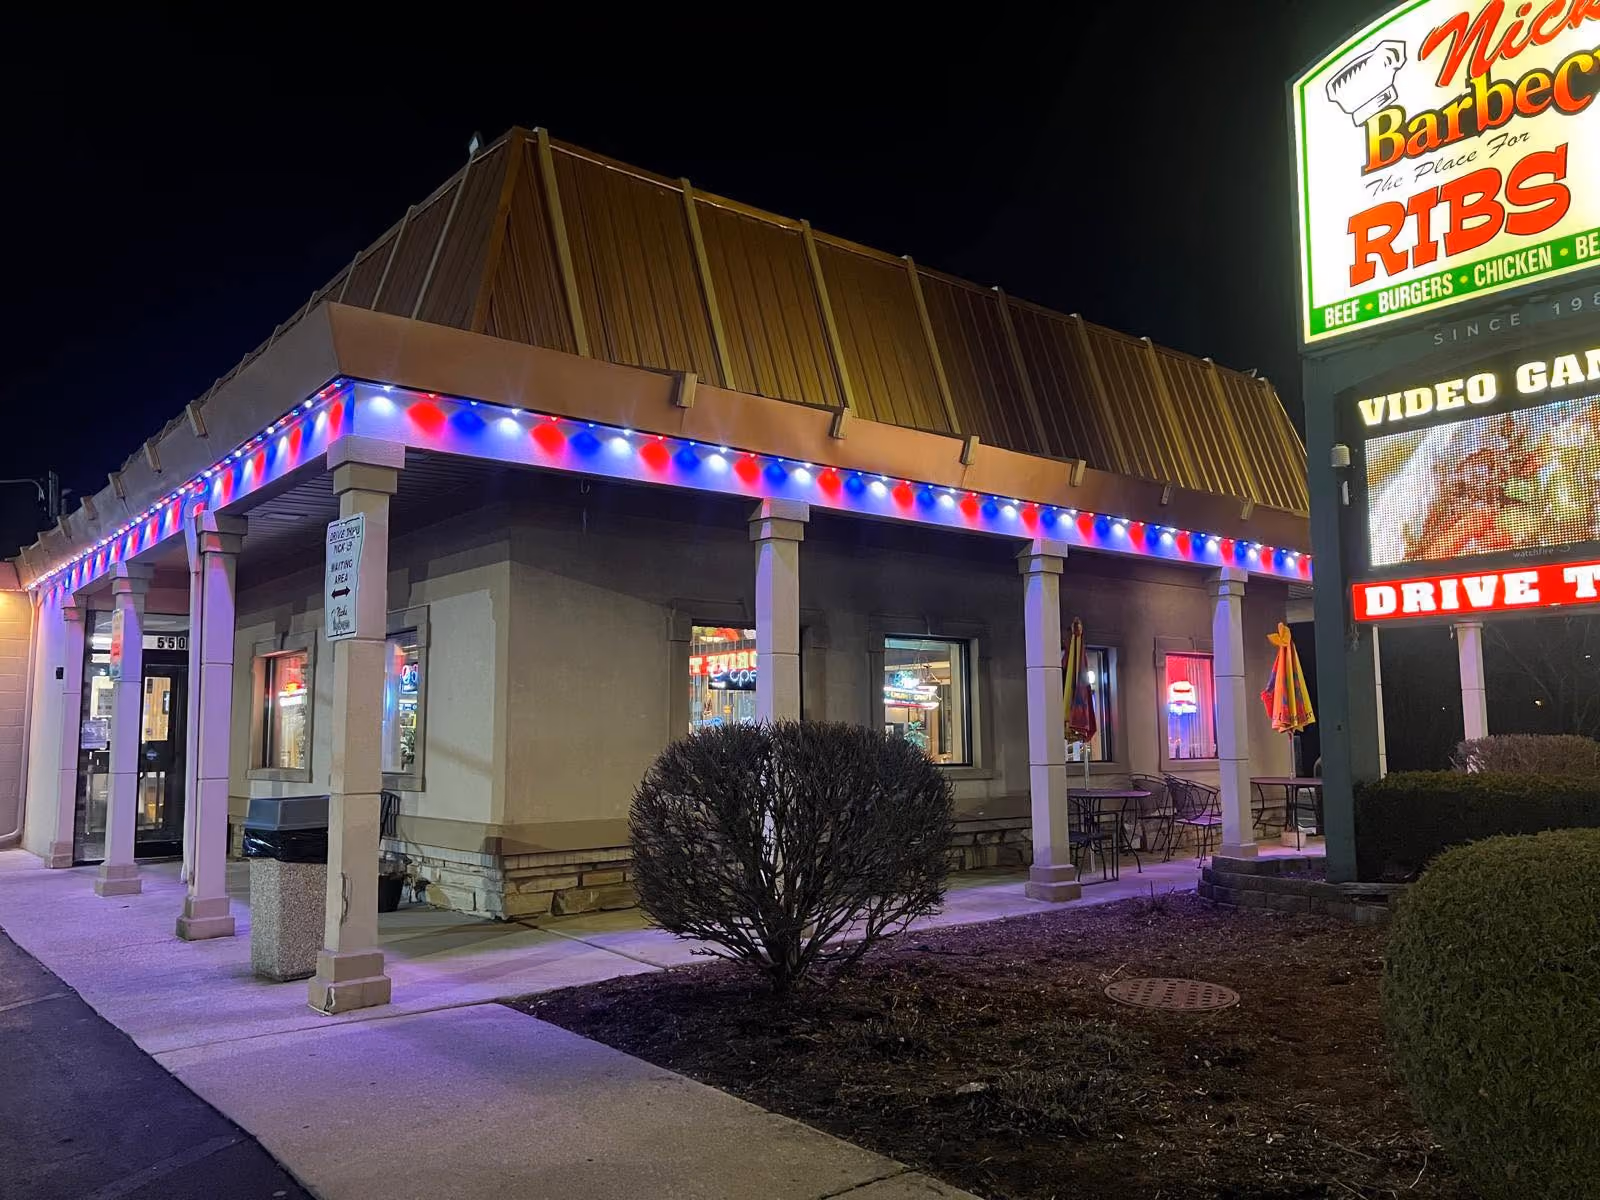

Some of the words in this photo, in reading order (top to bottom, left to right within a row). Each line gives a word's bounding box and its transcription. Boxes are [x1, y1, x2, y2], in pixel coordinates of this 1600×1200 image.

[1361, 46, 1600, 176] BarbeC
[1365, 174, 1403, 197] The
[1414, 150, 1478, 183] Place
[1486, 132, 1530, 158] For
[1347, 143, 1571, 287] RIBS
[1324, 299, 1361, 329] BEEF
[1378, 273, 1453, 313] BURGERS
[1473, 246, 1552, 286] CHICKEN
[1434, 313, 1520, 345] SINCE
[1357, 373, 1497, 426] VIDEO
[1365, 571, 1539, 616] DRIVE
